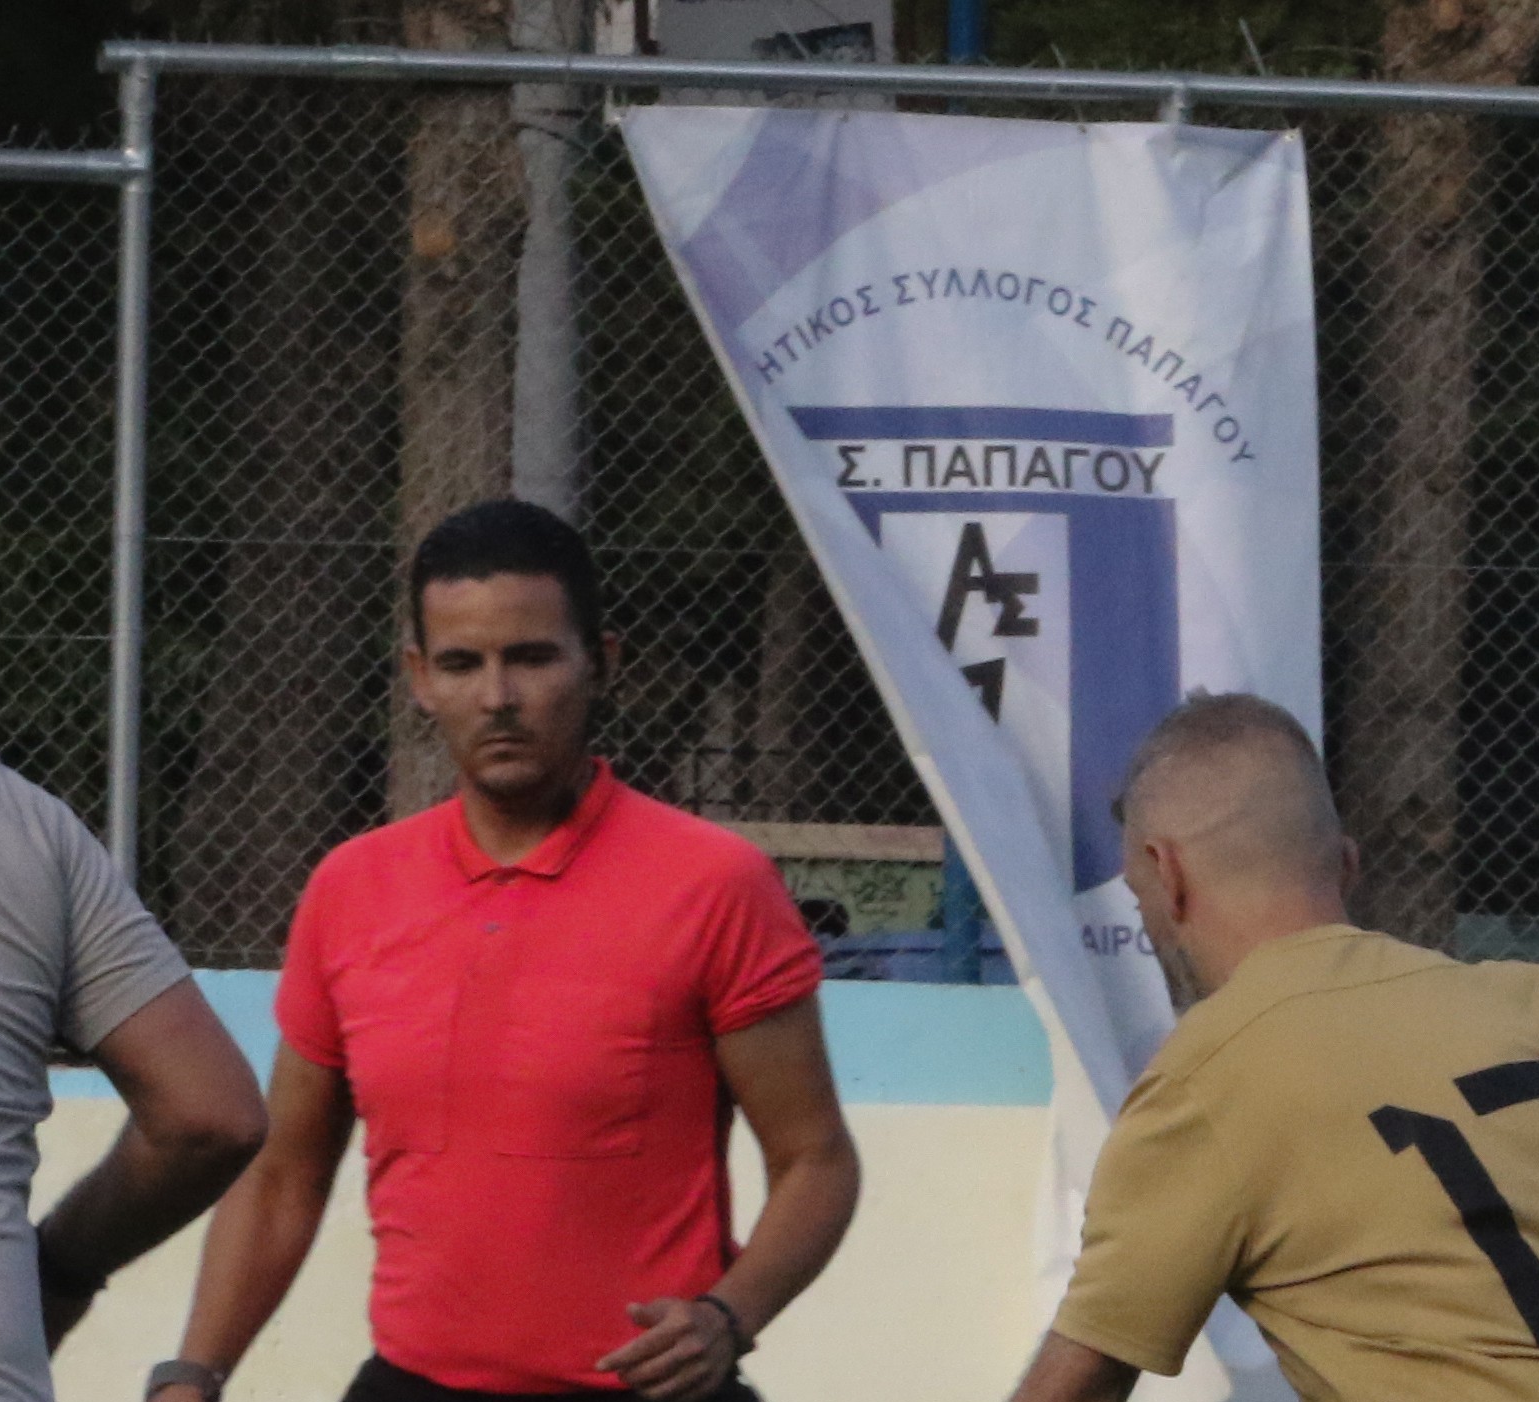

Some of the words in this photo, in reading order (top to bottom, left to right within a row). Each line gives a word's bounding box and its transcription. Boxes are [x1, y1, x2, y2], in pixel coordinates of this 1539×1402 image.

[893, 268, 1097, 328] ΣΥΛΛΟΓΟΣ
[1105, 316, 1256, 465] ΠΑΠΑΓΟΥ
[903, 445, 1165, 493] ΠΑΠΑΓΟΥ
